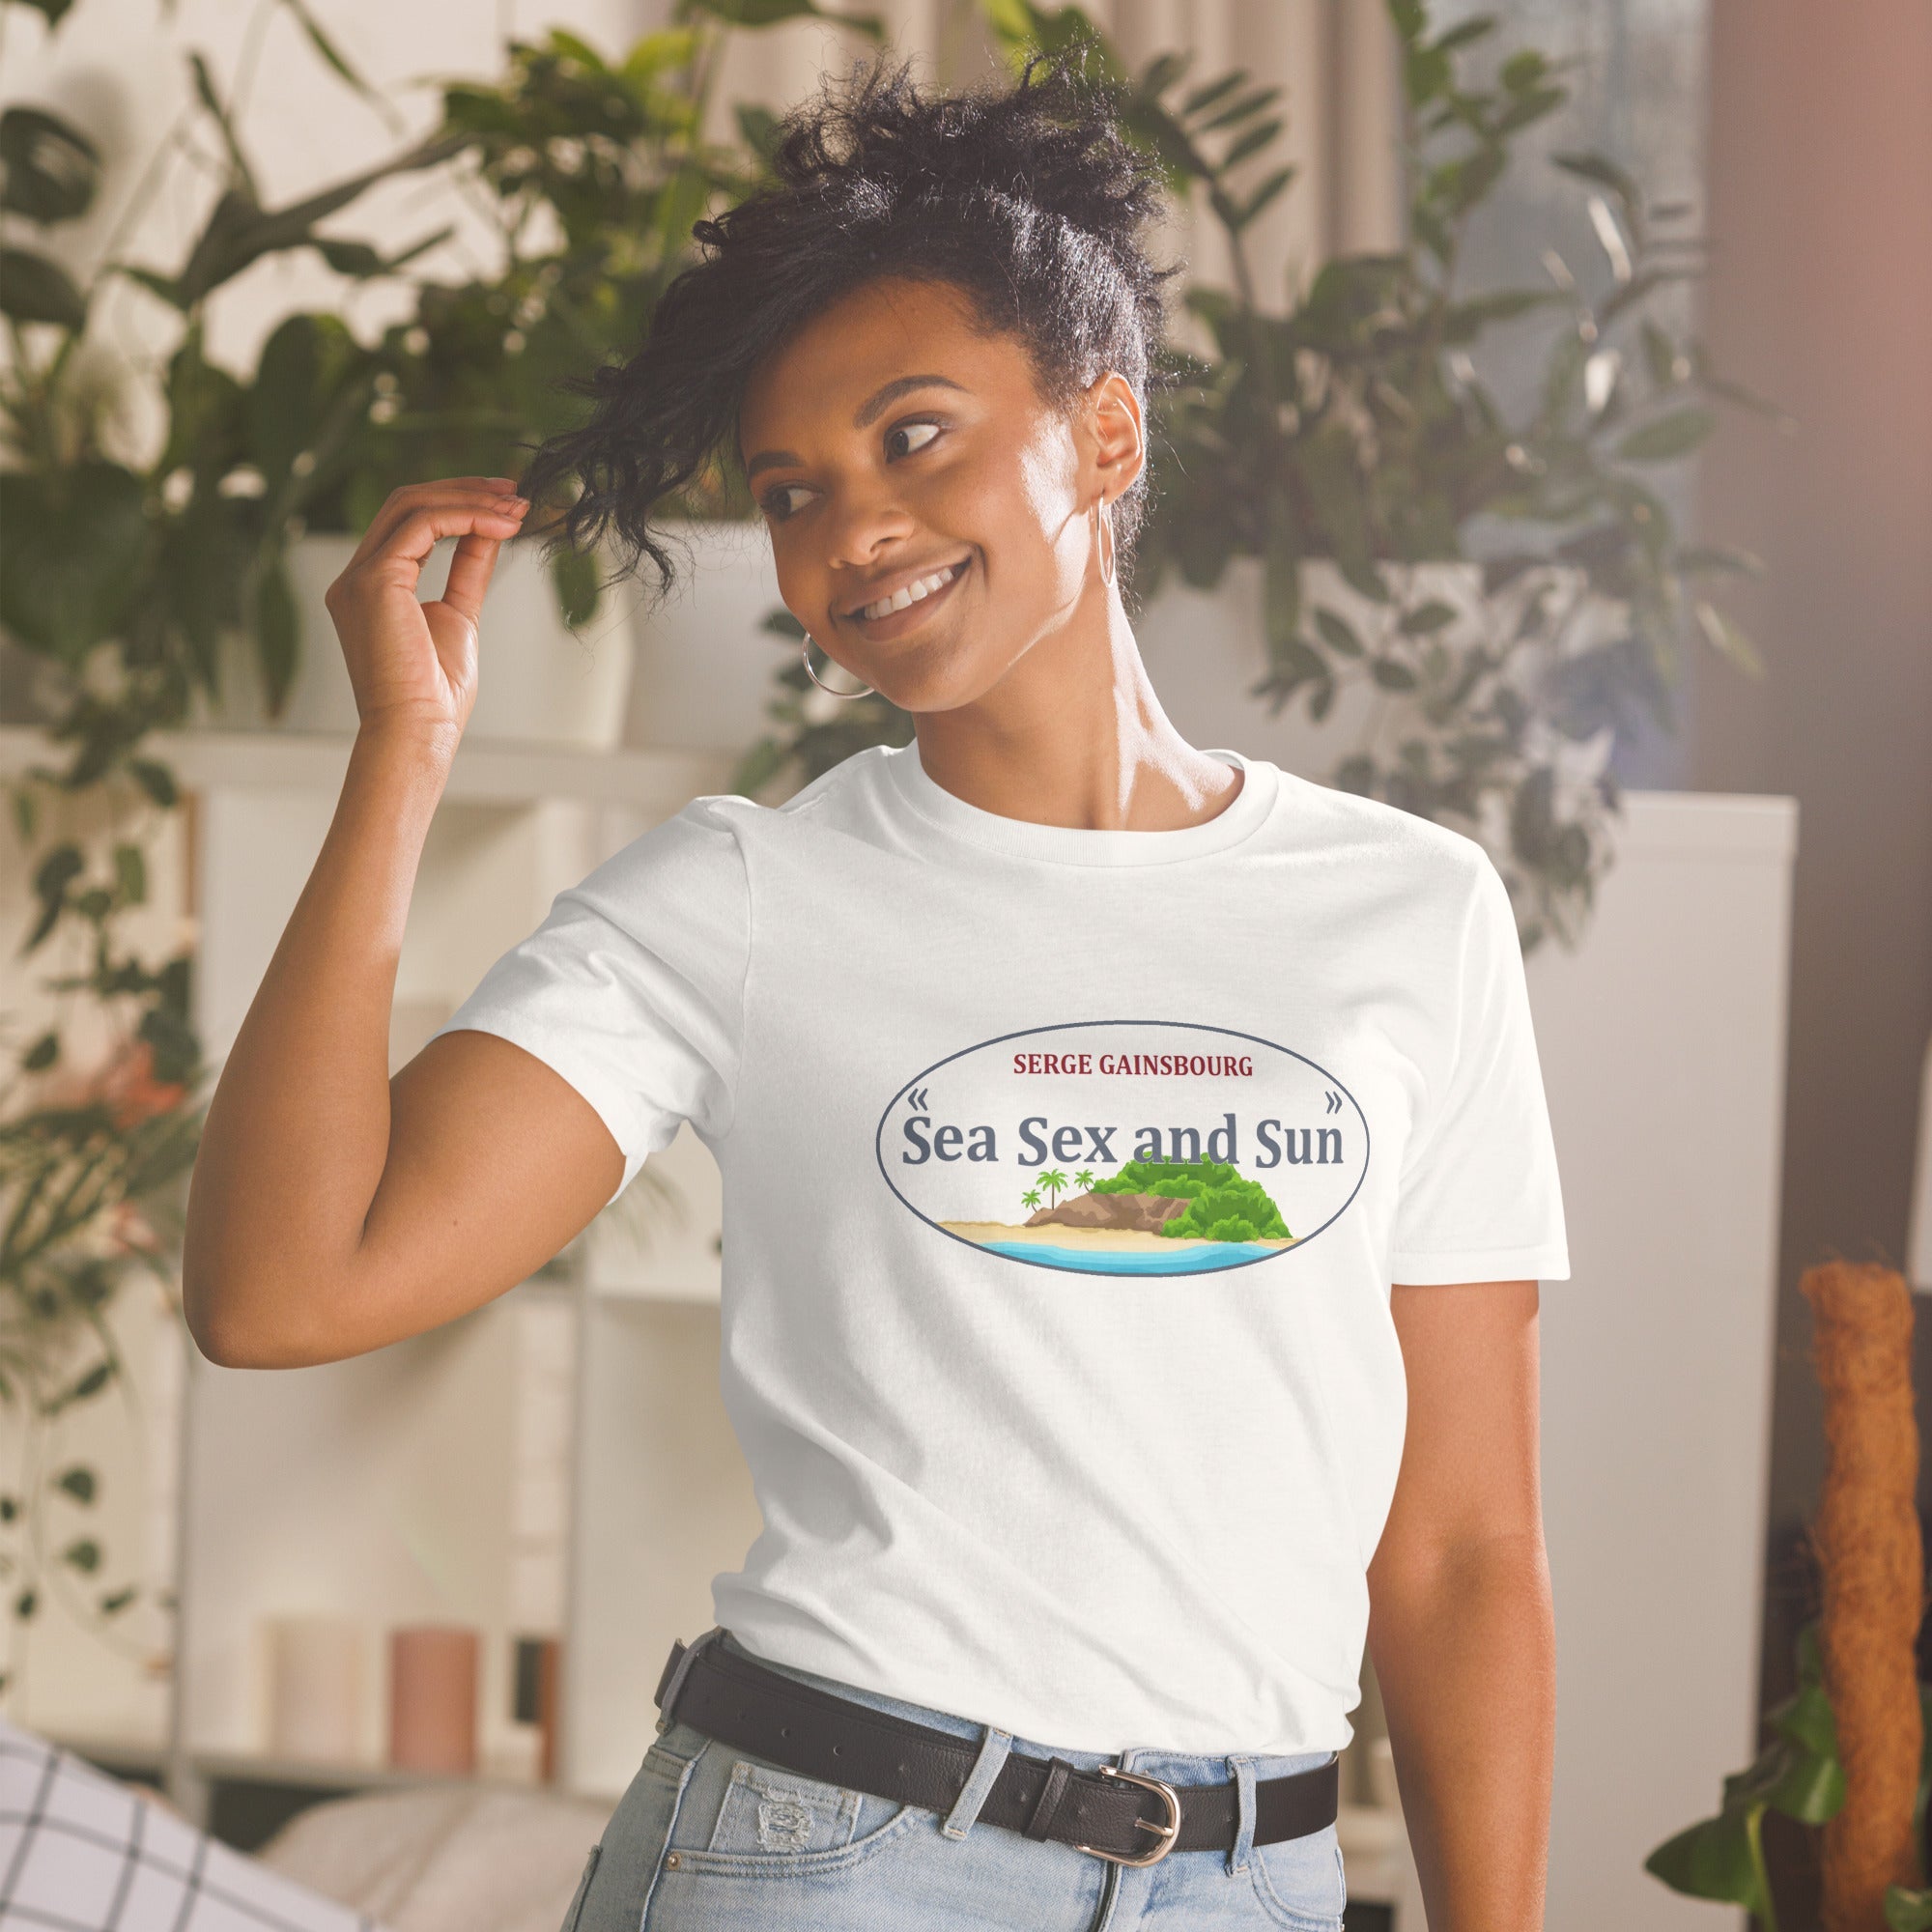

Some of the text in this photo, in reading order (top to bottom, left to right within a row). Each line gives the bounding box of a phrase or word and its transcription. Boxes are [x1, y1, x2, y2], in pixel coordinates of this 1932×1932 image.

[1013, 1054, 1253, 1077] SERGE GAINSBOURG
[1017, 1117, 1119, 1167] Sex
[1133, 1113, 1240, 1165] and
